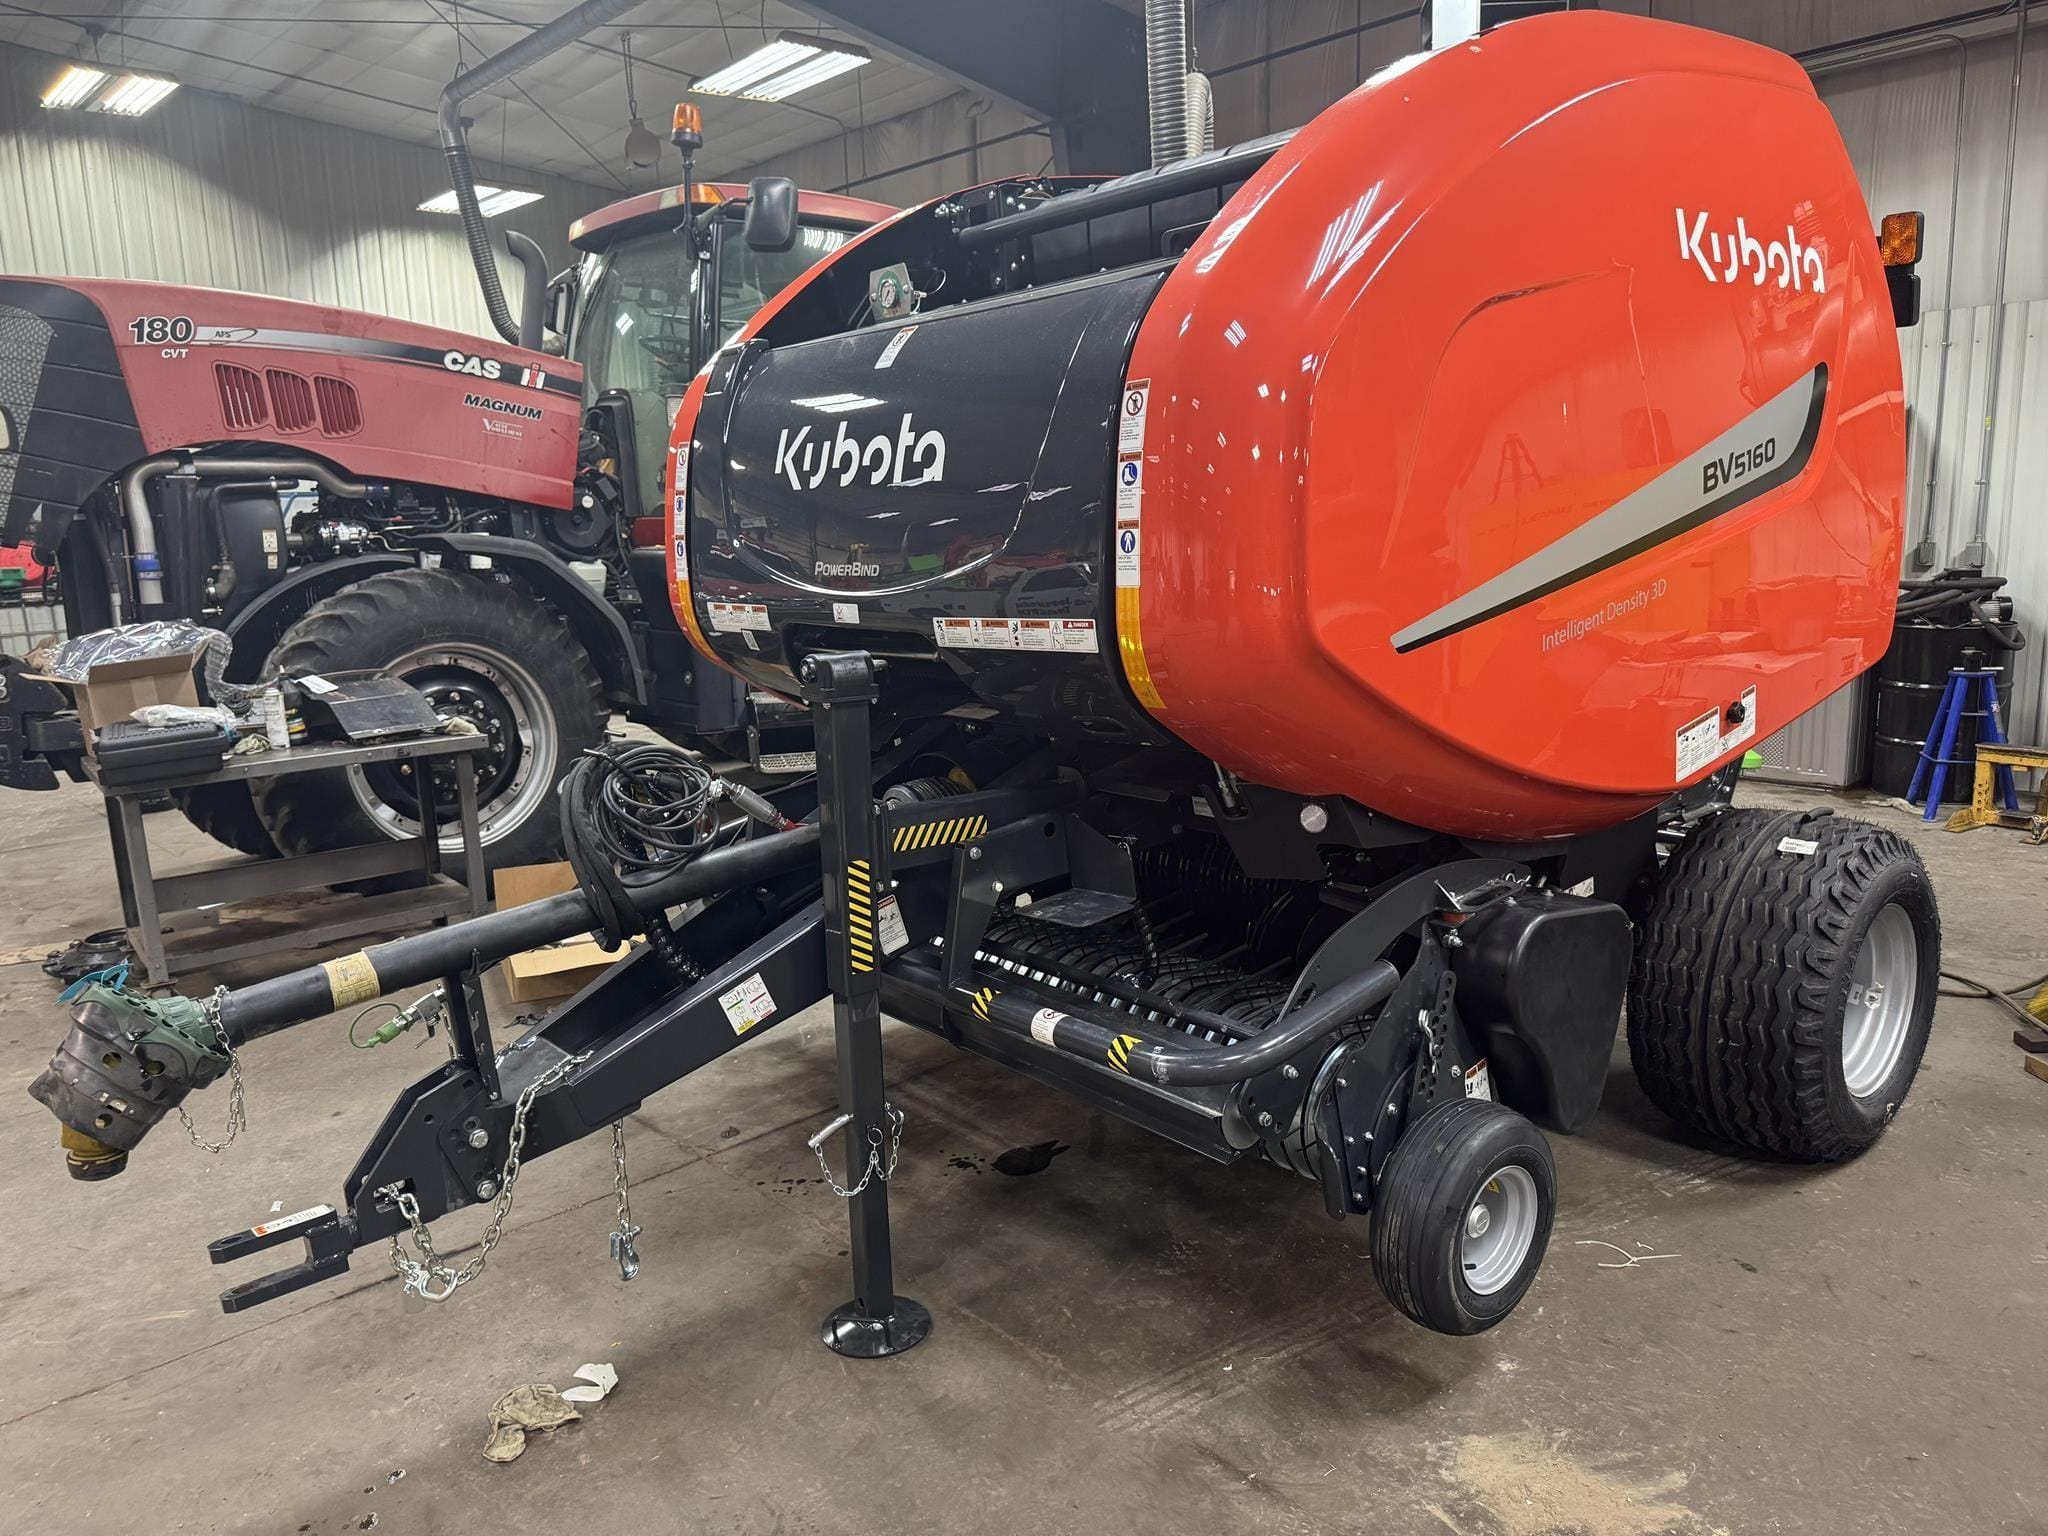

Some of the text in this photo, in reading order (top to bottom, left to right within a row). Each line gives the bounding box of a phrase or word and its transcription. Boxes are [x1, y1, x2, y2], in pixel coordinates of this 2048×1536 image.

[1675, 208, 1826, 294] Kubota
[128, 315, 195, 345] 180
[215, 330, 232, 338] AFS
[161, 348, 189, 359] CVT
[463, 393, 544, 421] MAGNUM
[774, 412, 946, 491] Kubota
[1703, 437, 1776, 495] BV5160
[1542, 578, 1667, 652] Intelligent Density 3D
